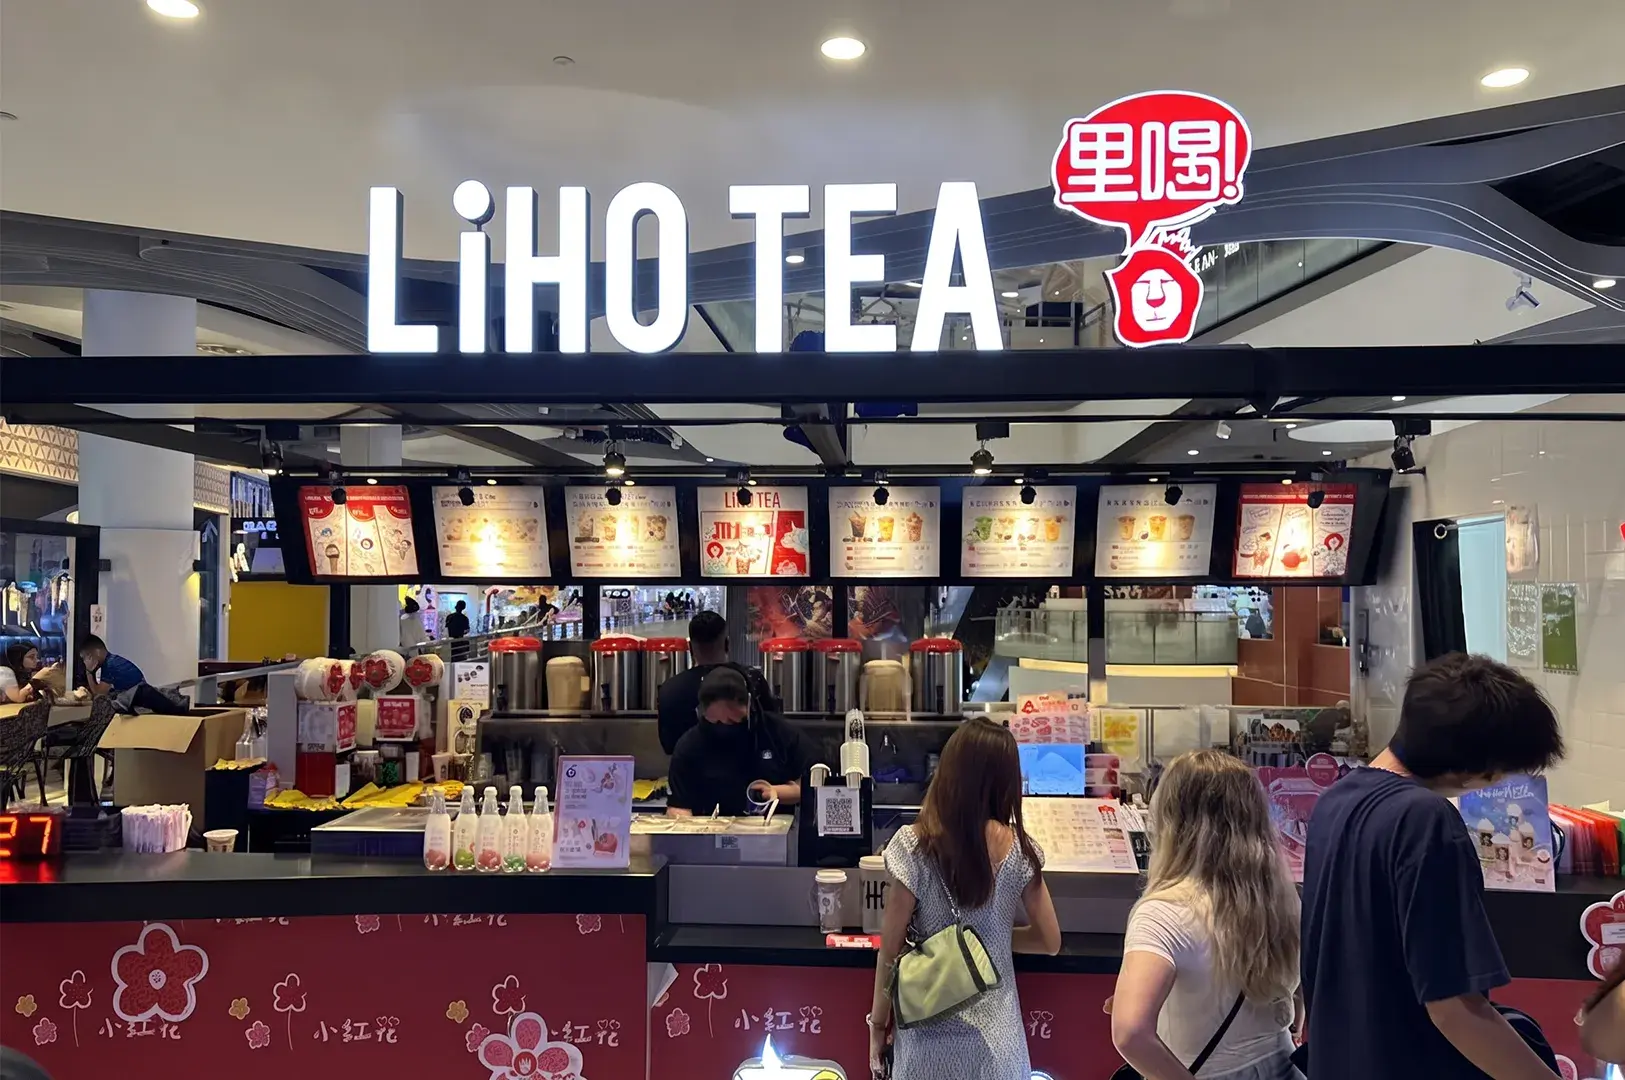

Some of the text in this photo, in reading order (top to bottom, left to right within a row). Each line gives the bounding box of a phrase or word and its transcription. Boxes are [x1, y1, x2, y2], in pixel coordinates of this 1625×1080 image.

[367, 180, 1004, 353] LiHO TEA
[756, 492, 781, 508] TEA
[551, 1019, 620, 1047] 红花
